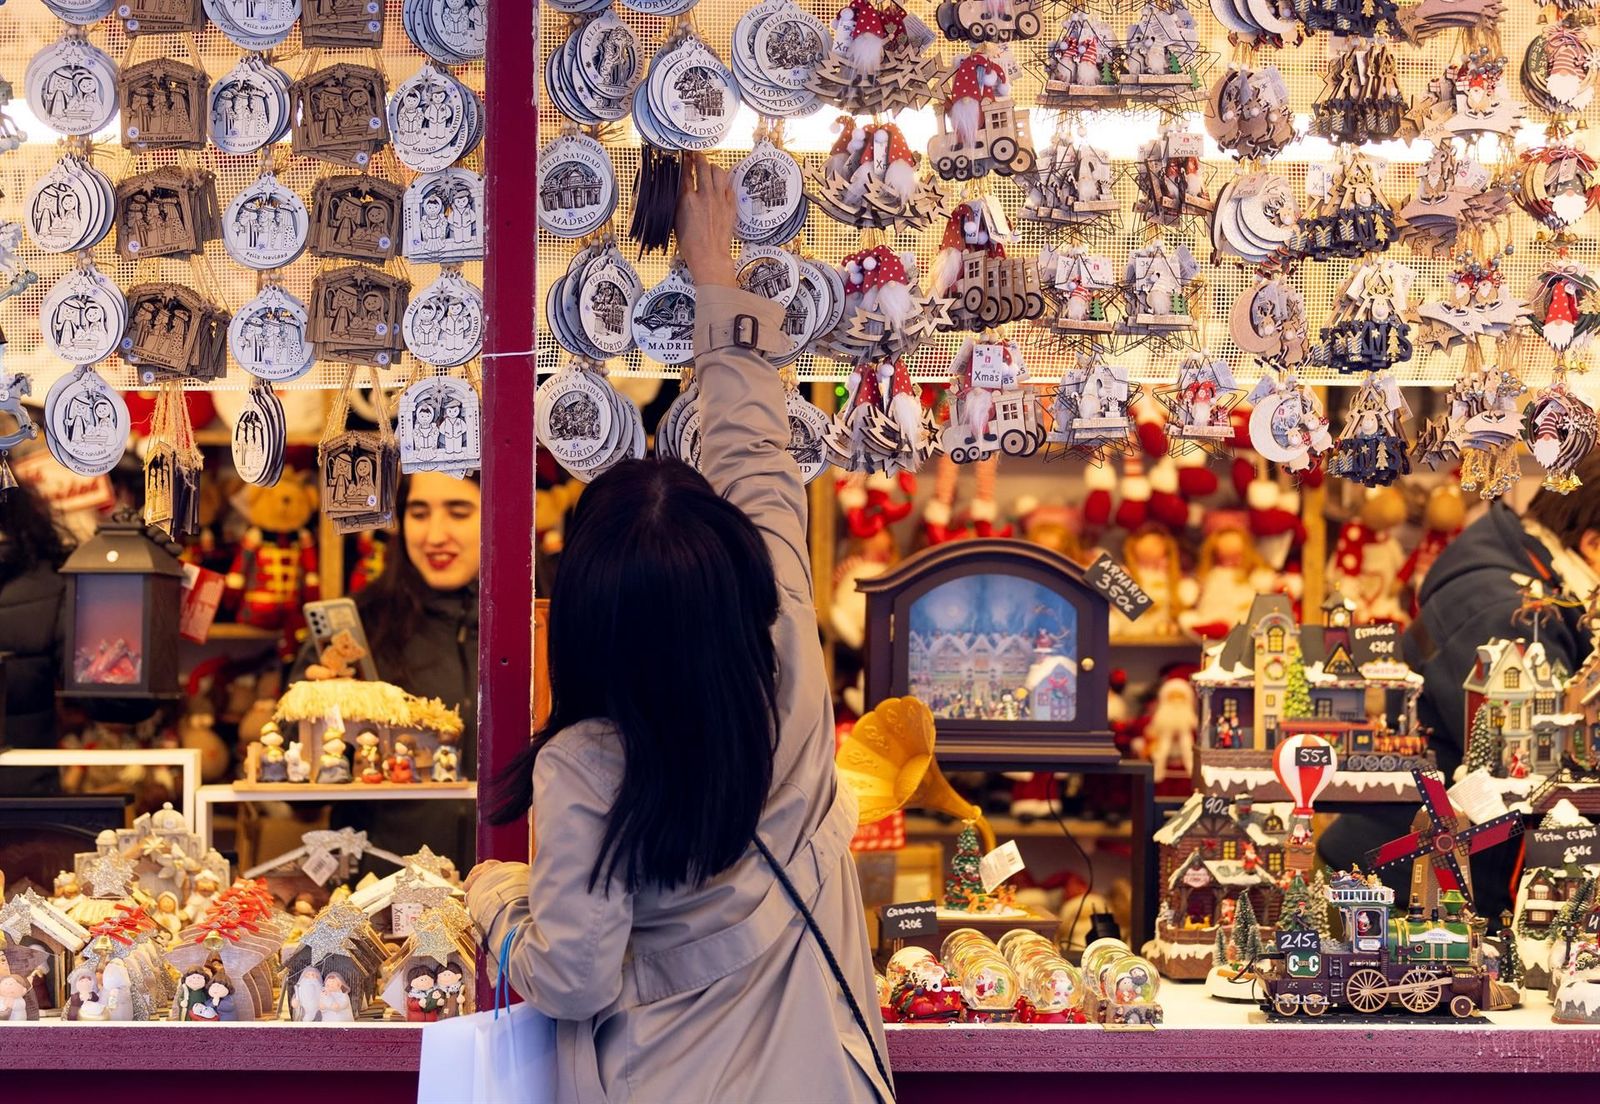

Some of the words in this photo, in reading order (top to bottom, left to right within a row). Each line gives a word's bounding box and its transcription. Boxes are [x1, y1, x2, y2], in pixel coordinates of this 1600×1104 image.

[747, 5, 769, 21] FELIZ
[763, 15, 784, 31] FELIZ
[787, 13, 823, 32] NAVIDAD
[584, 23, 602, 47] FELIZ
[663, 52, 684, 68] FELIZ
[672, 60, 694, 76] FELIZ
[696, 58, 732, 80] NAVIDAD
[449, 105, 462, 134] NAVIDAD
[682, 123, 724, 136] MADRID
[678, 136, 719, 150] MADRID
[540, 155, 561, 174] FELIZ
[564, 152, 601, 169] NAVIDAD
[741, 155, 759, 173] FELIZ
[762, 151, 794, 167] NAVIDAD
[551, 211, 596, 226] MADRID
[749, 212, 788, 228] MADRID
[746, 248, 783, 260] NAVIDAD
[589, 274, 605, 286] FELIZ
[607, 274, 632, 300] NAVIDAD
[645, 285, 666, 300] FELIZ
[467, 317, 480, 345] NAVIDAD
[592, 335, 623, 351] MADRID
[542, 377, 562, 392] FELIZ
[974, 371, 1000, 382] Xmas
[550, 384, 569, 401] FELIZ
[572, 382, 603, 402] NAVIDAD
[789, 409, 816, 426] AVIDAD
[554, 445, 594, 458] MADRID
[1098, 560, 1148, 604] ARMARIO
[394, 908, 403, 932] Xmas
[1281, 932, 1318, 949] 215€
